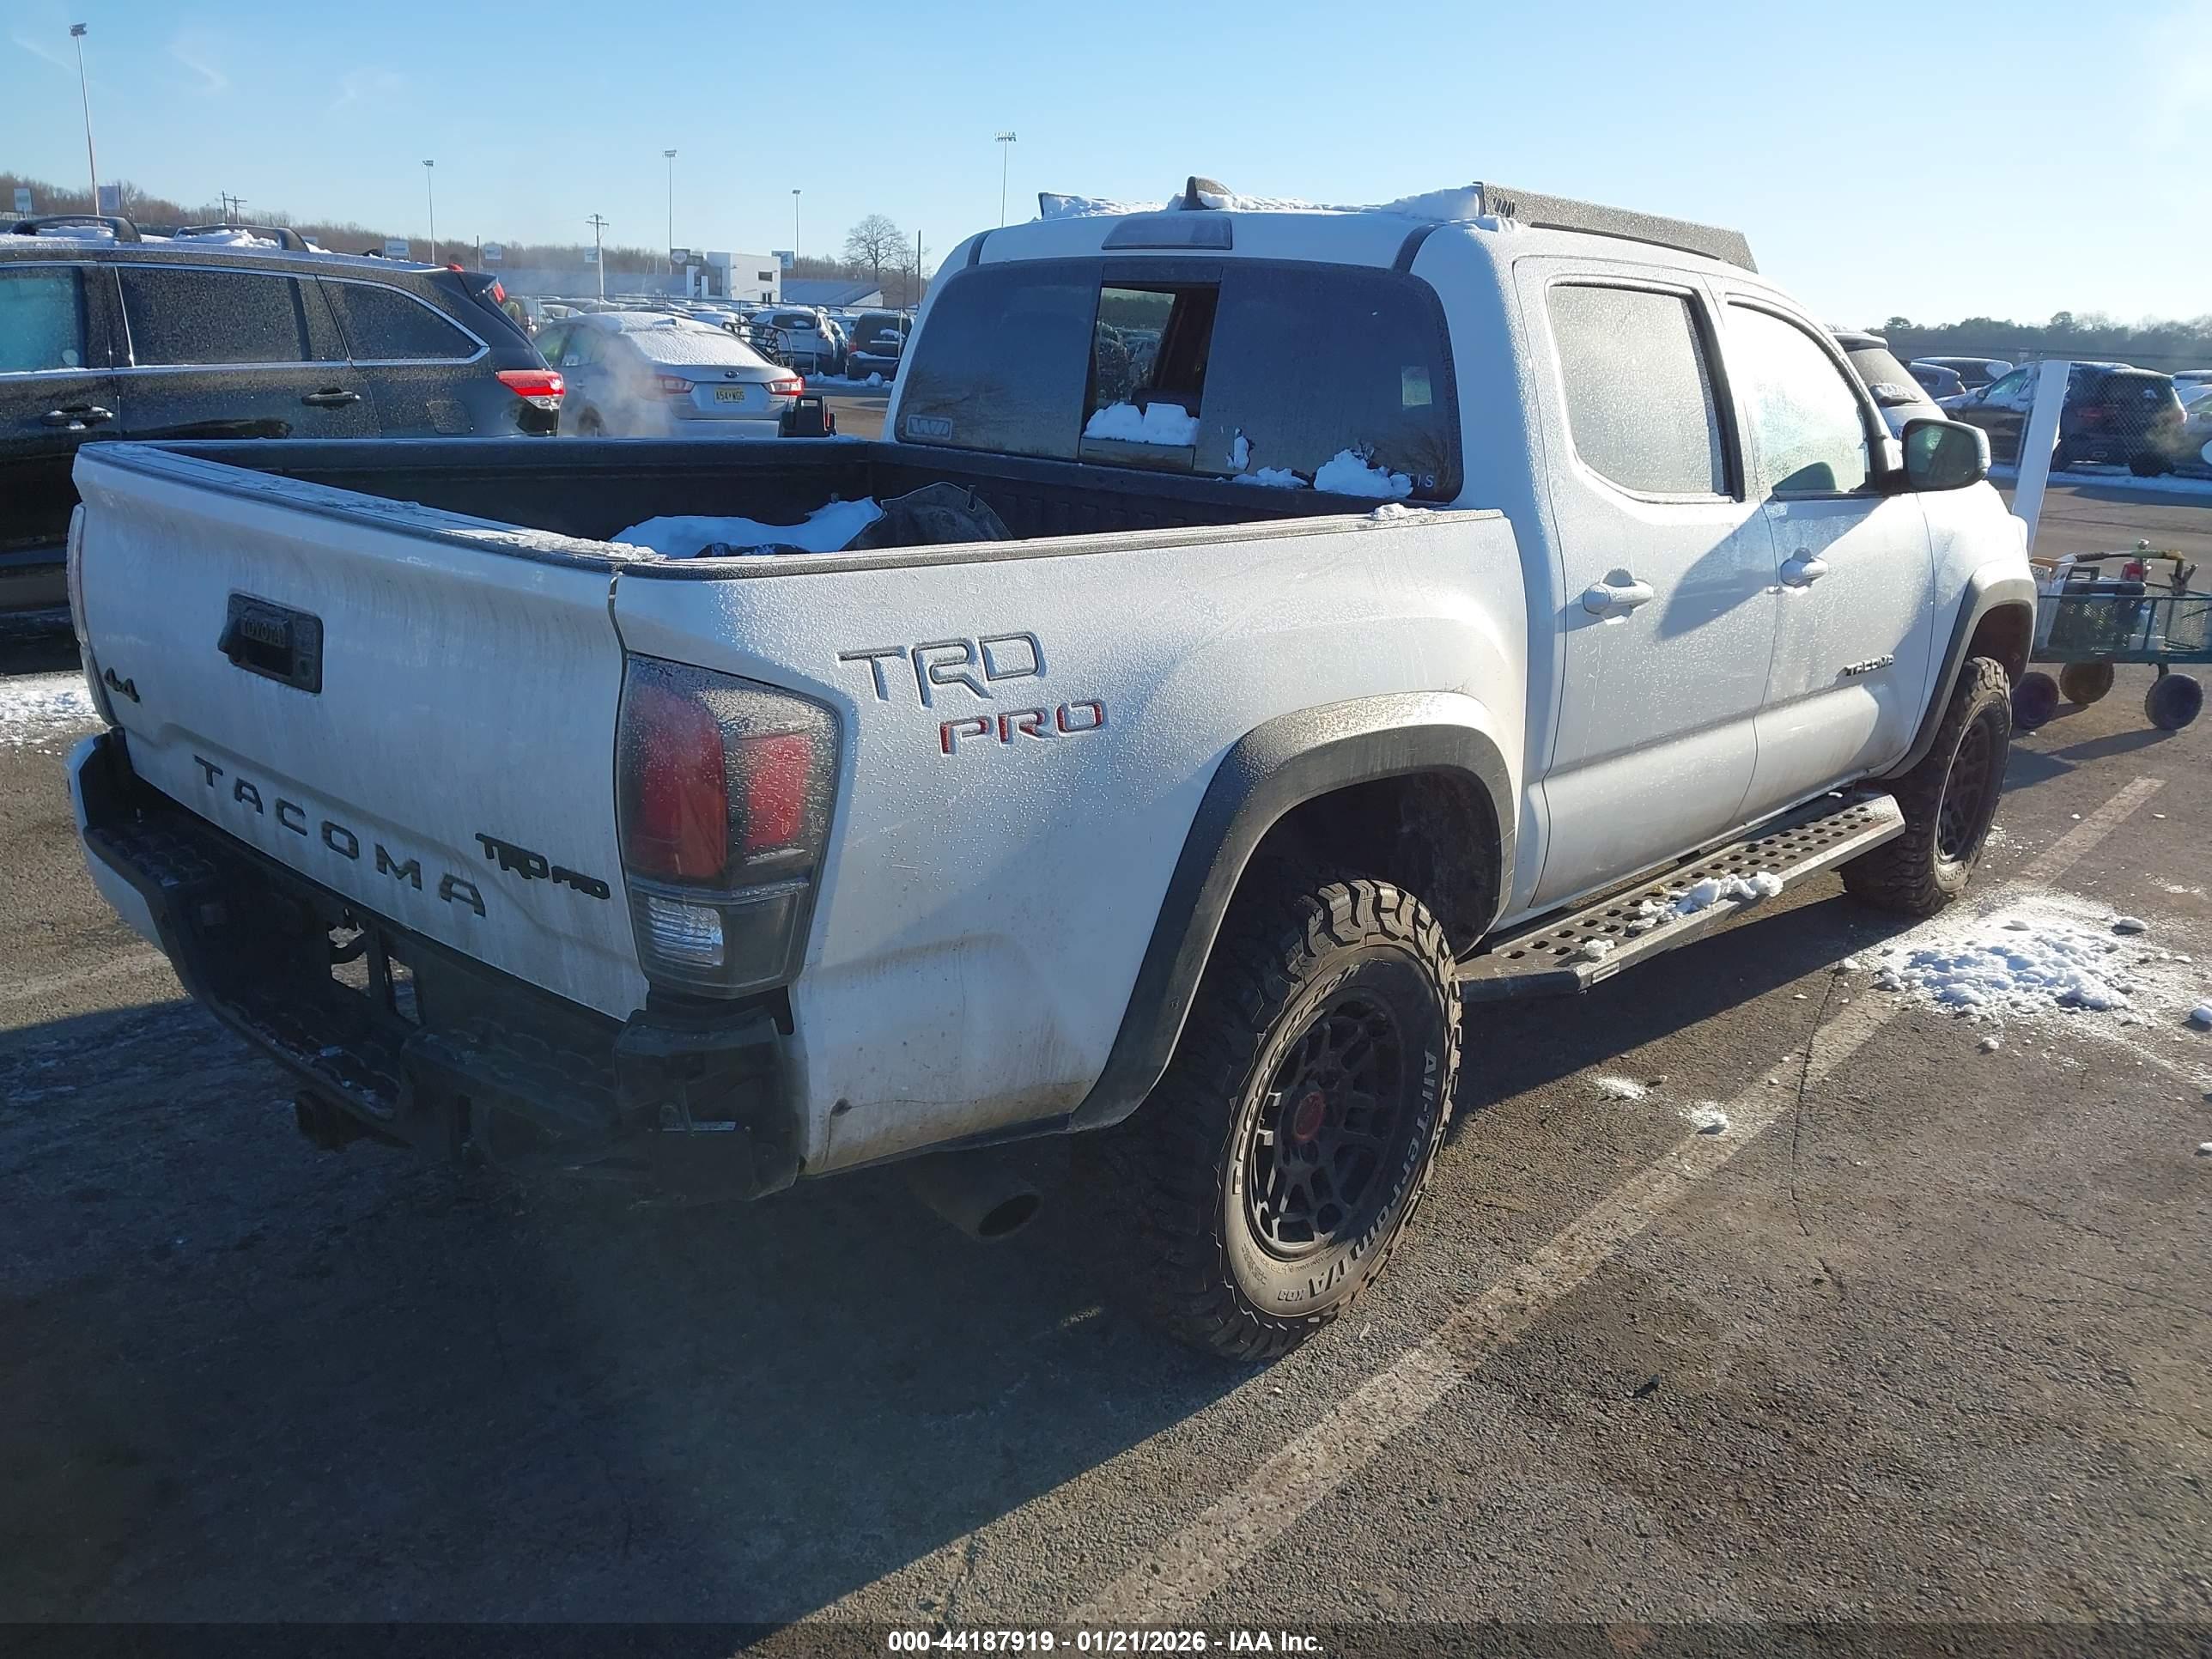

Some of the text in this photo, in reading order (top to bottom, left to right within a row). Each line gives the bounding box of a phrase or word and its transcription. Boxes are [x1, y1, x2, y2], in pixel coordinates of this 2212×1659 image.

[240, 619, 287, 648] TOYOTA
[838, 631, 1045, 708] TRD
[1844, 653, 1894, 677] TACOMA
[939, 699, 1106, 755] PRO
[192, 755, 487, 918] TACOMA
[475, 832, 611, 900] TRD PRO
